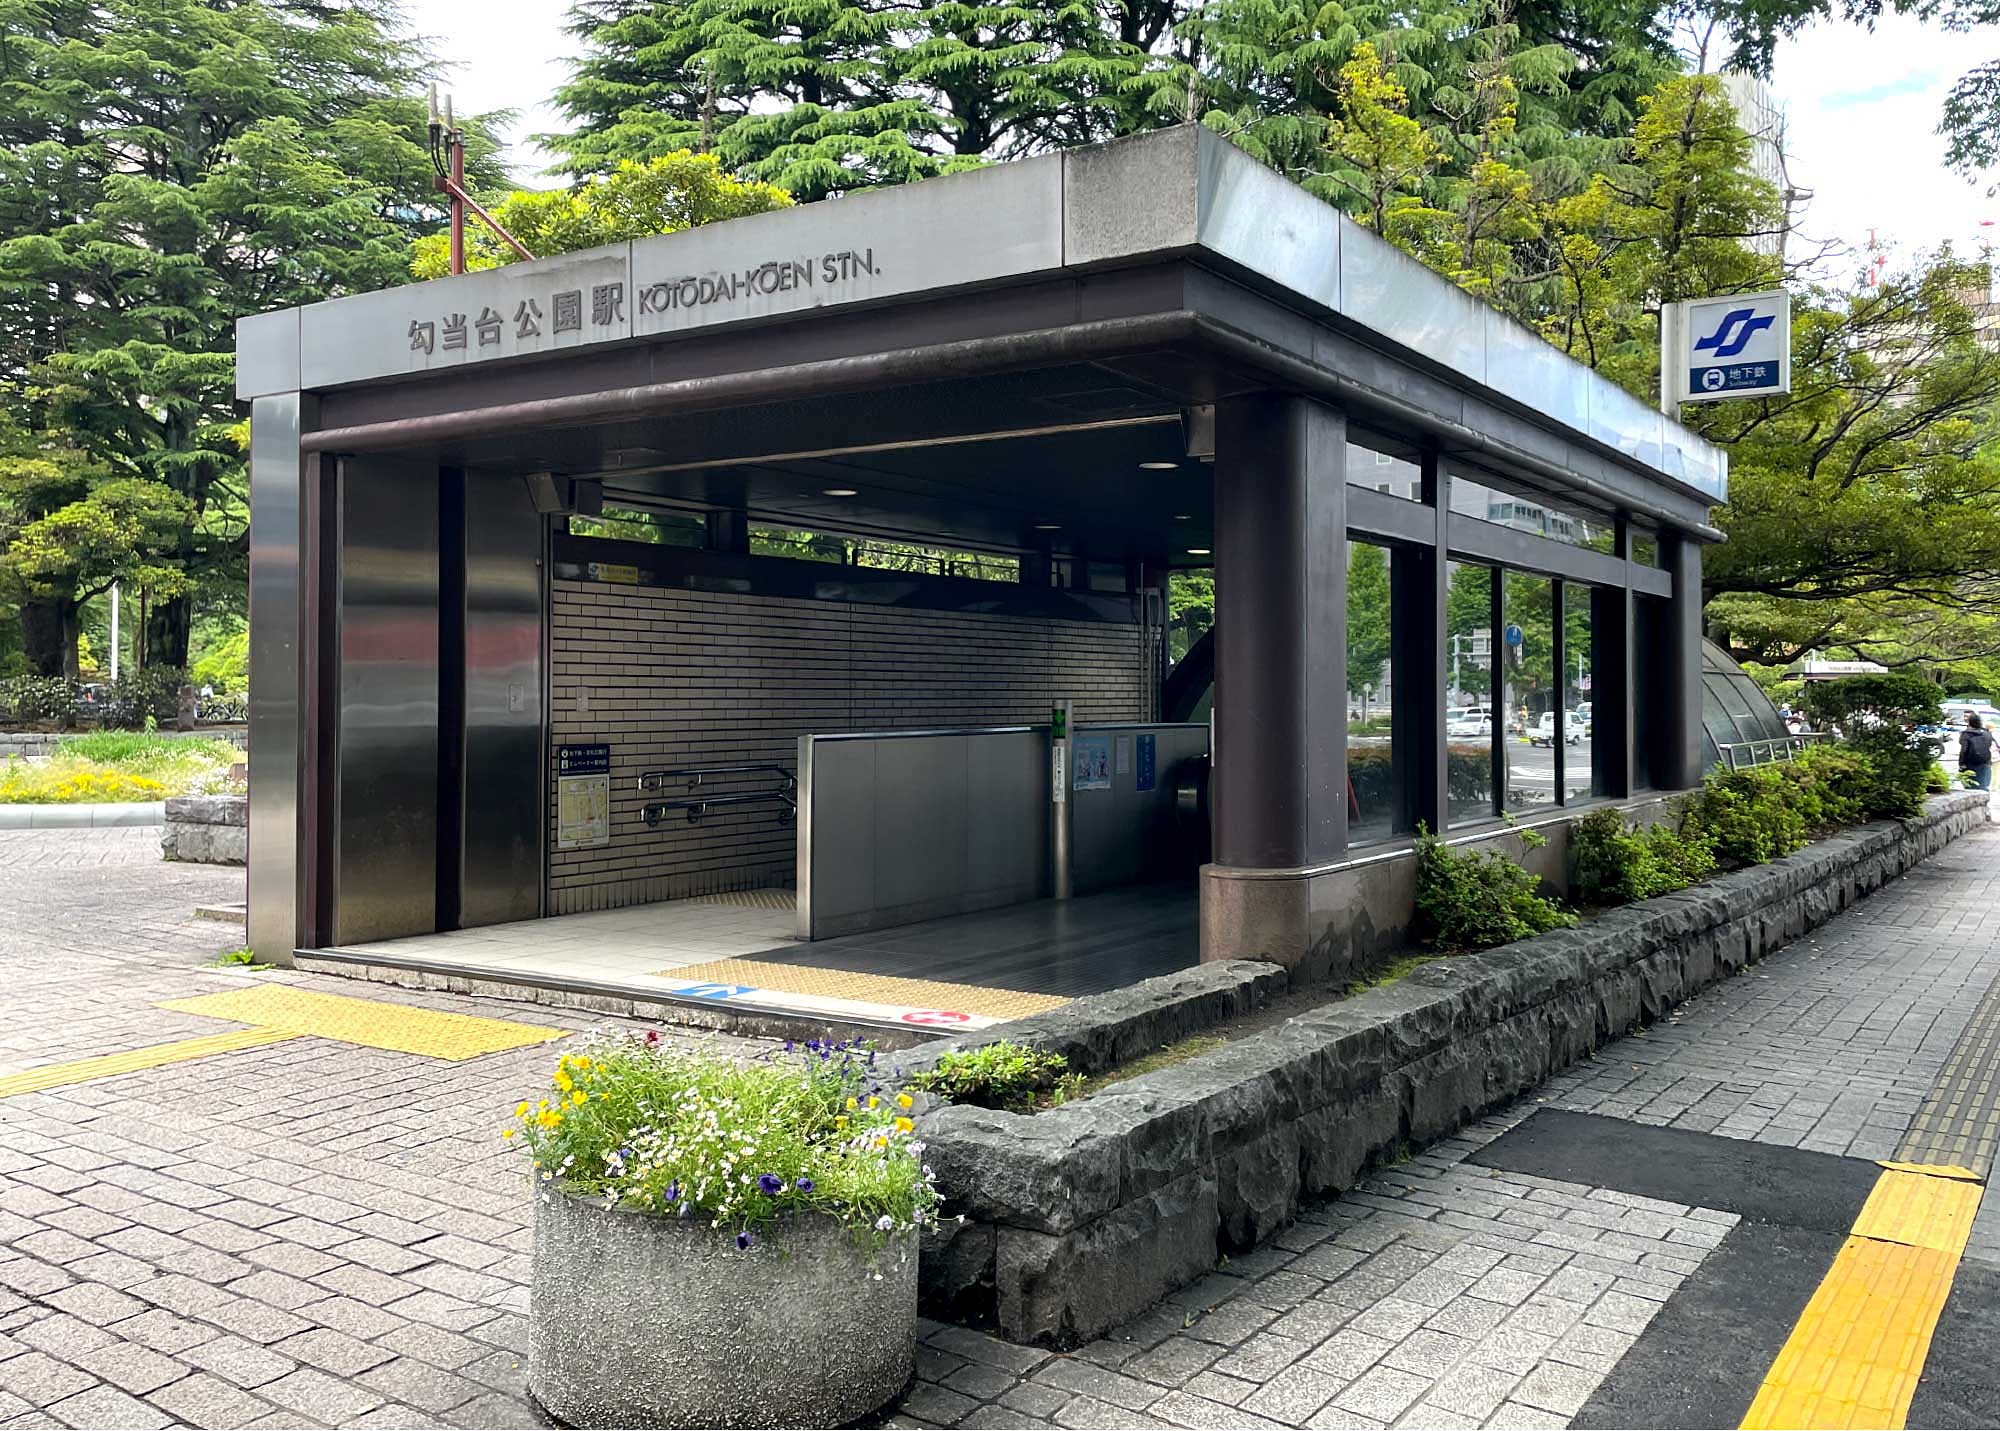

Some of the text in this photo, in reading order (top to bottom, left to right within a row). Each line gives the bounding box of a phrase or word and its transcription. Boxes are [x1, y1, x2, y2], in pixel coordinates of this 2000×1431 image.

[639, 247, 881, 314] KŌTŌDAI-KŌEN STN.
[408, 282, 624, 354] 勾当台公園駅
[1729, 366, 1766, 379] 地下鉄
